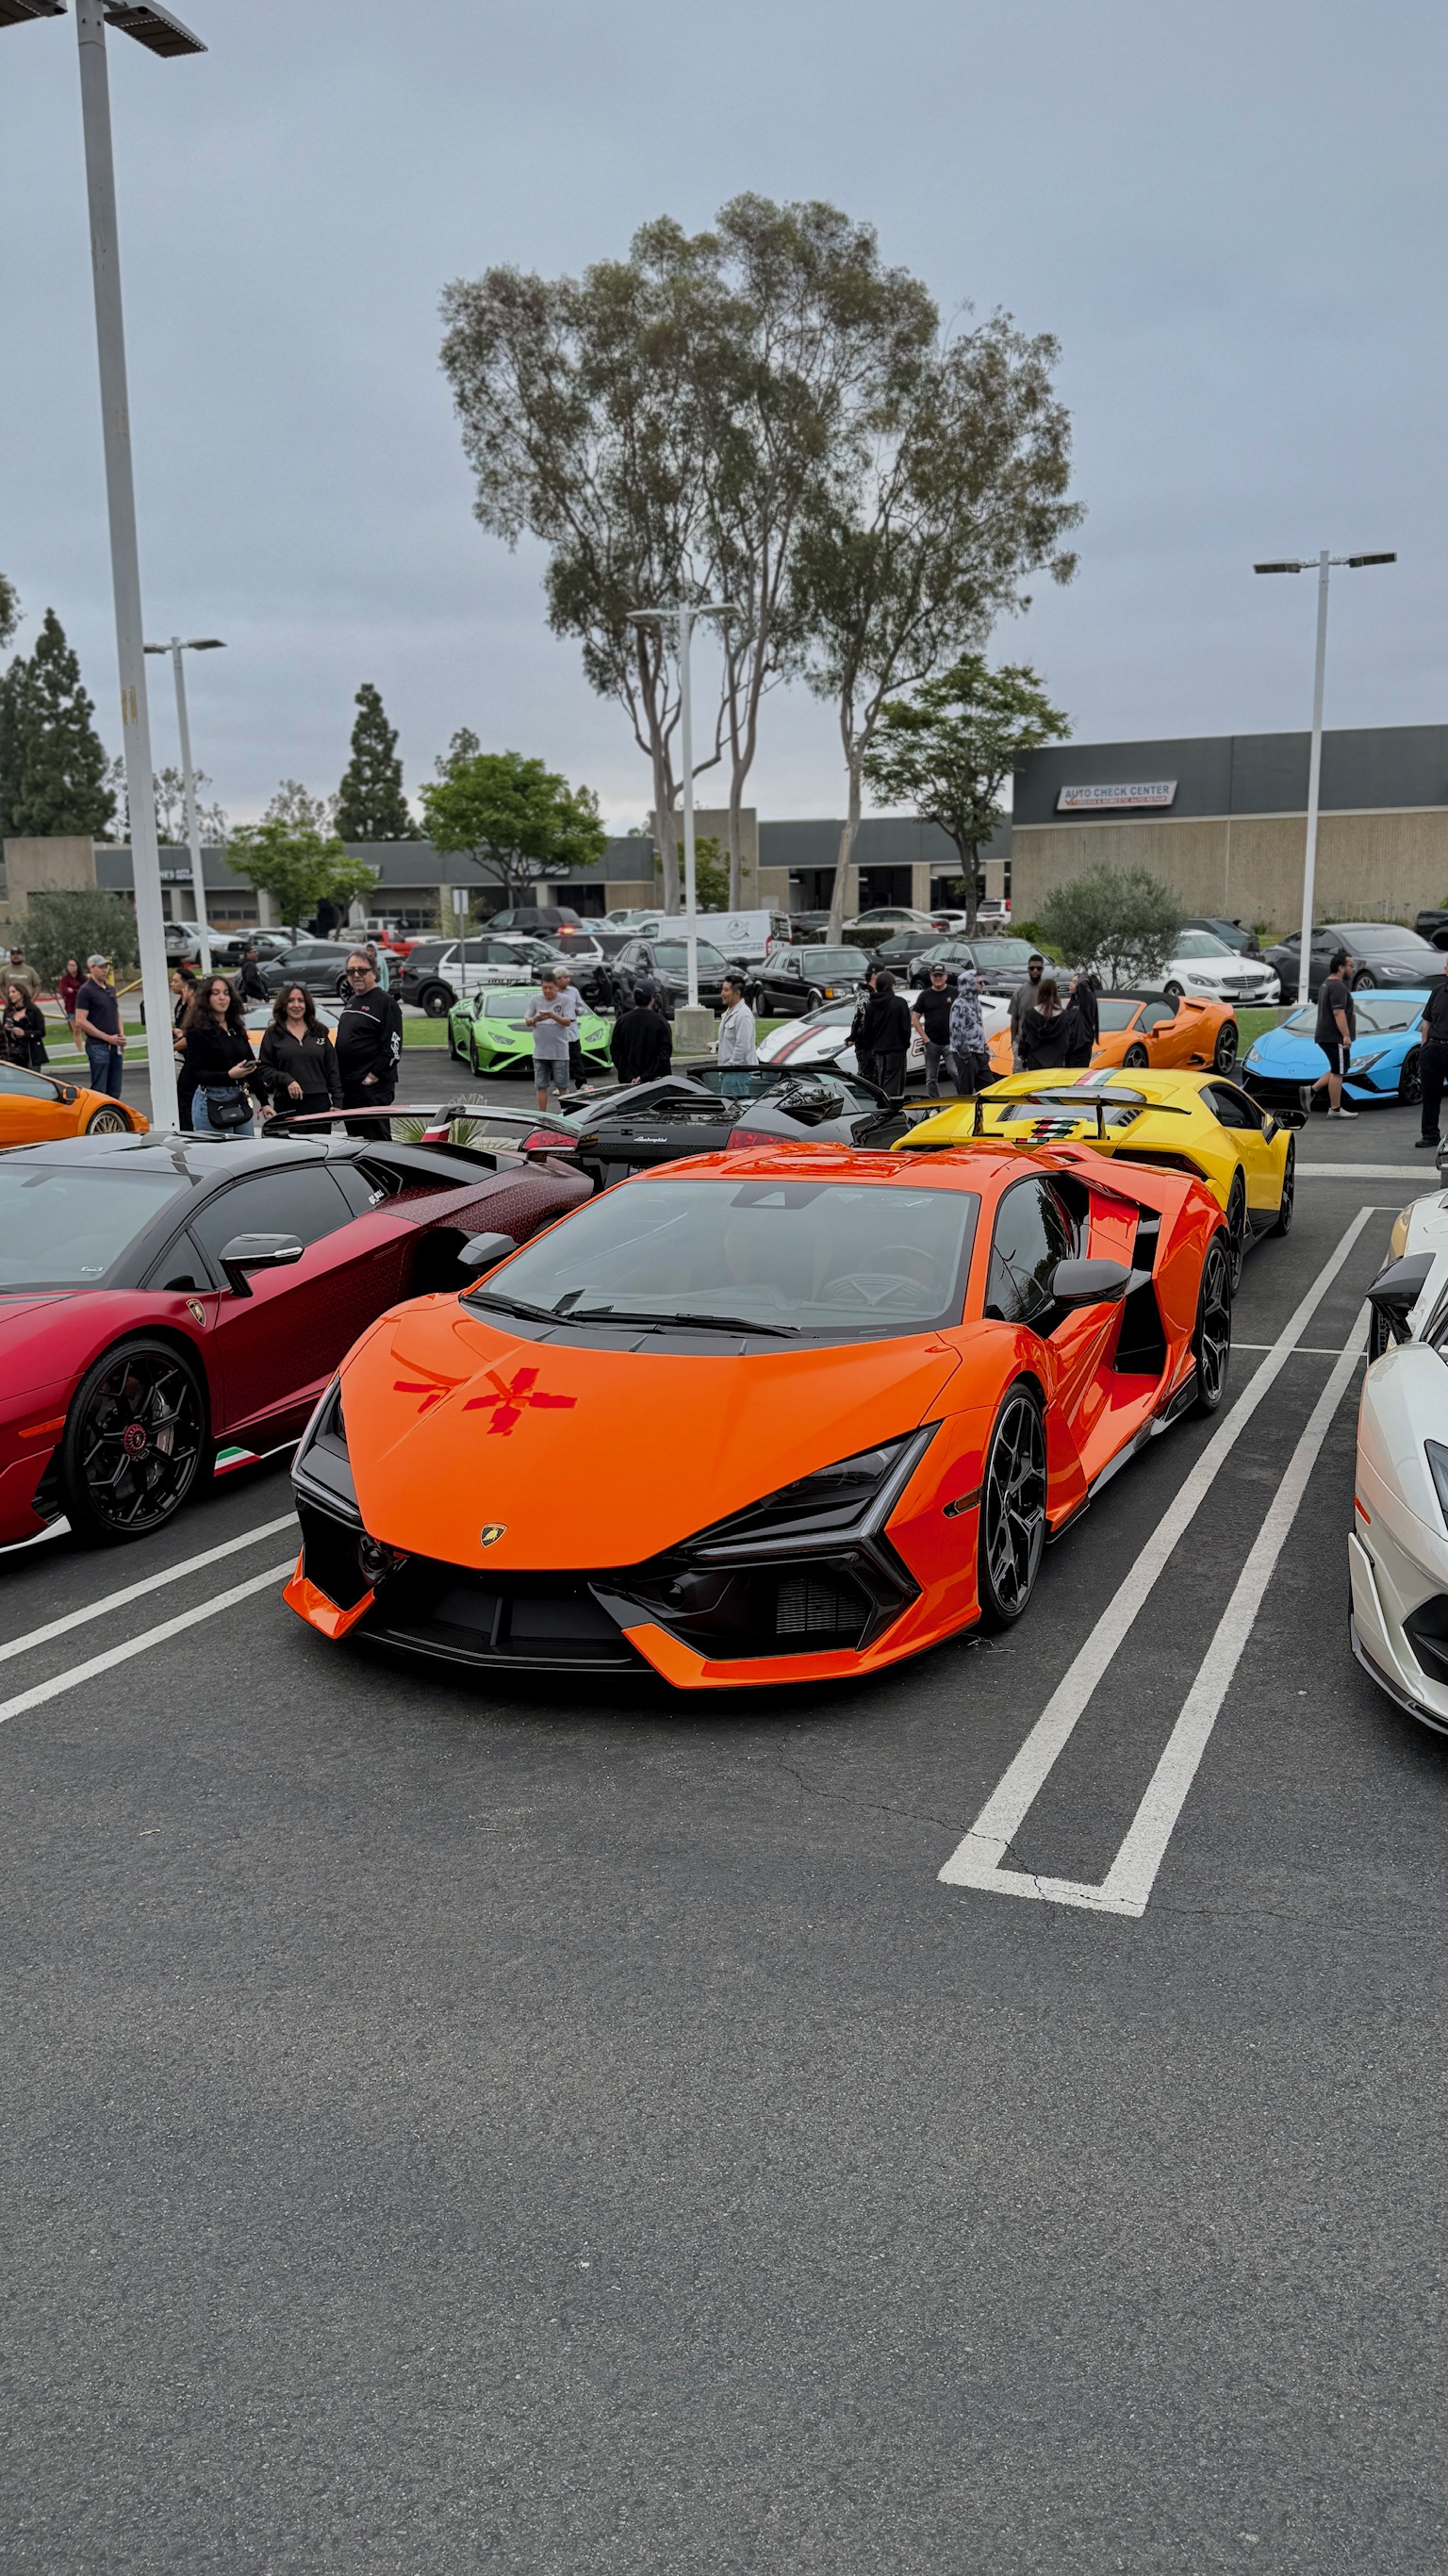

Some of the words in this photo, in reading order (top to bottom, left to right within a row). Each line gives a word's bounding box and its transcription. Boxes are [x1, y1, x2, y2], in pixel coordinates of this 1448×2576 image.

[1065, 788, 1092, 799] AUTO
[1094, 786, 1127, 798] CHECK
[1130, 784, 1170, 796] CENTER
